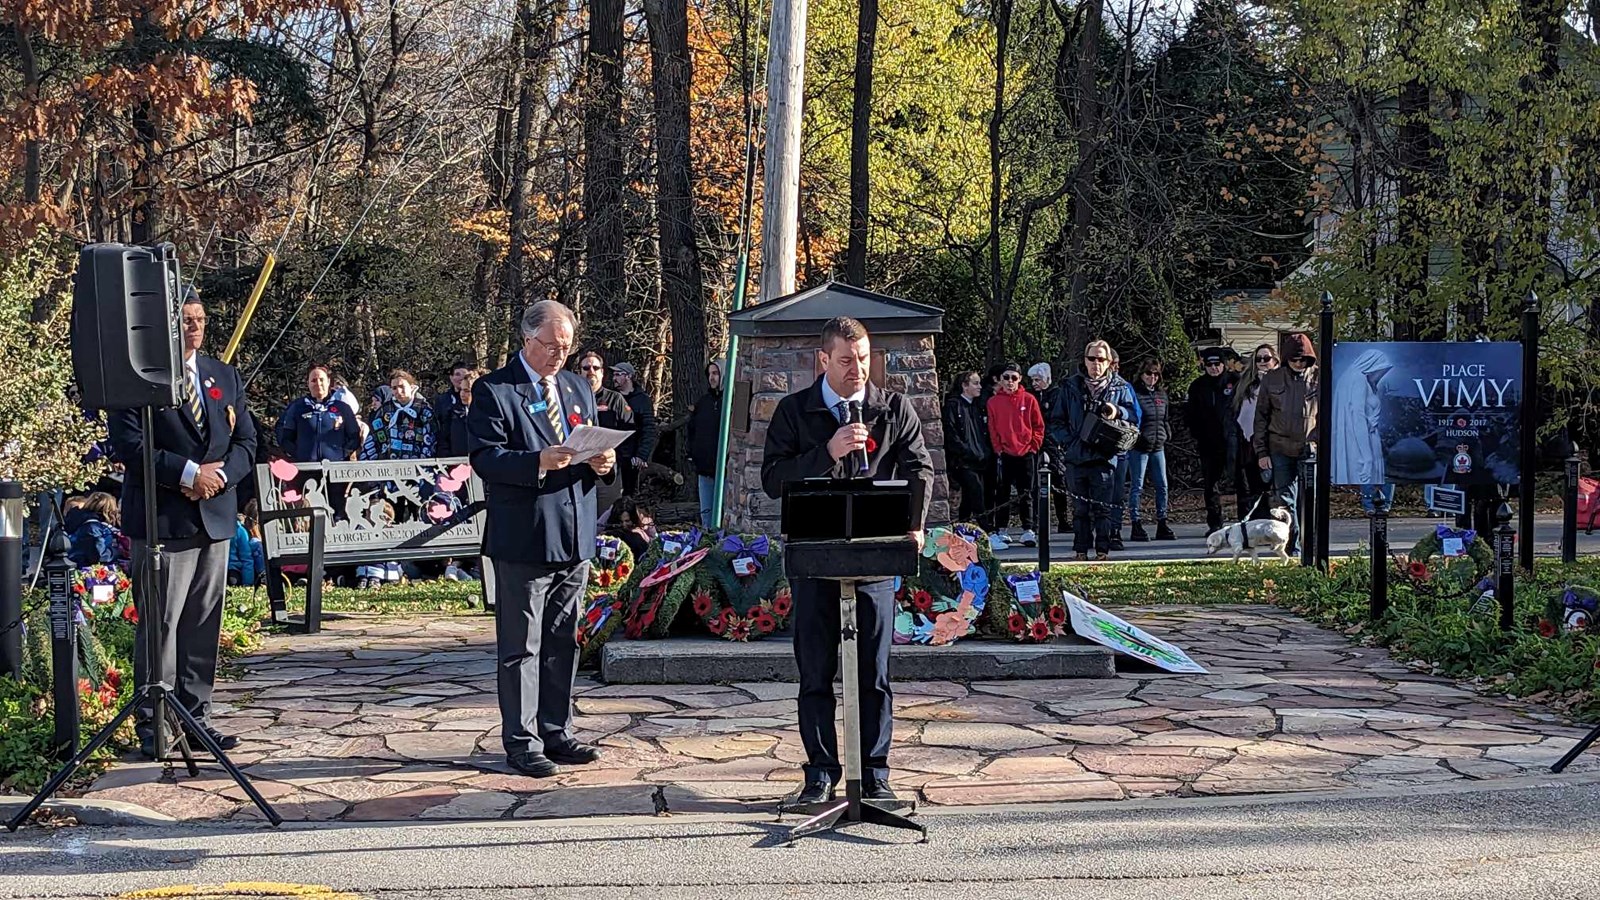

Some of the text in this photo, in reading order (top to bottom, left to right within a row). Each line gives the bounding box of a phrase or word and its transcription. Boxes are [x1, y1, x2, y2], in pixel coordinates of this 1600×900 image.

[1442, 364, 1486, 377] PLACE
[1411, 378, 1515, 408] VIMY
[1438, 419, 1487, 427] 1917 2017
[1446, 429, 1480, 437] HUDSON
[378, 467, 392, 477] BR.
[333, 532, 373, 543] FORGET
[456, 526, 473, 536] PAS
